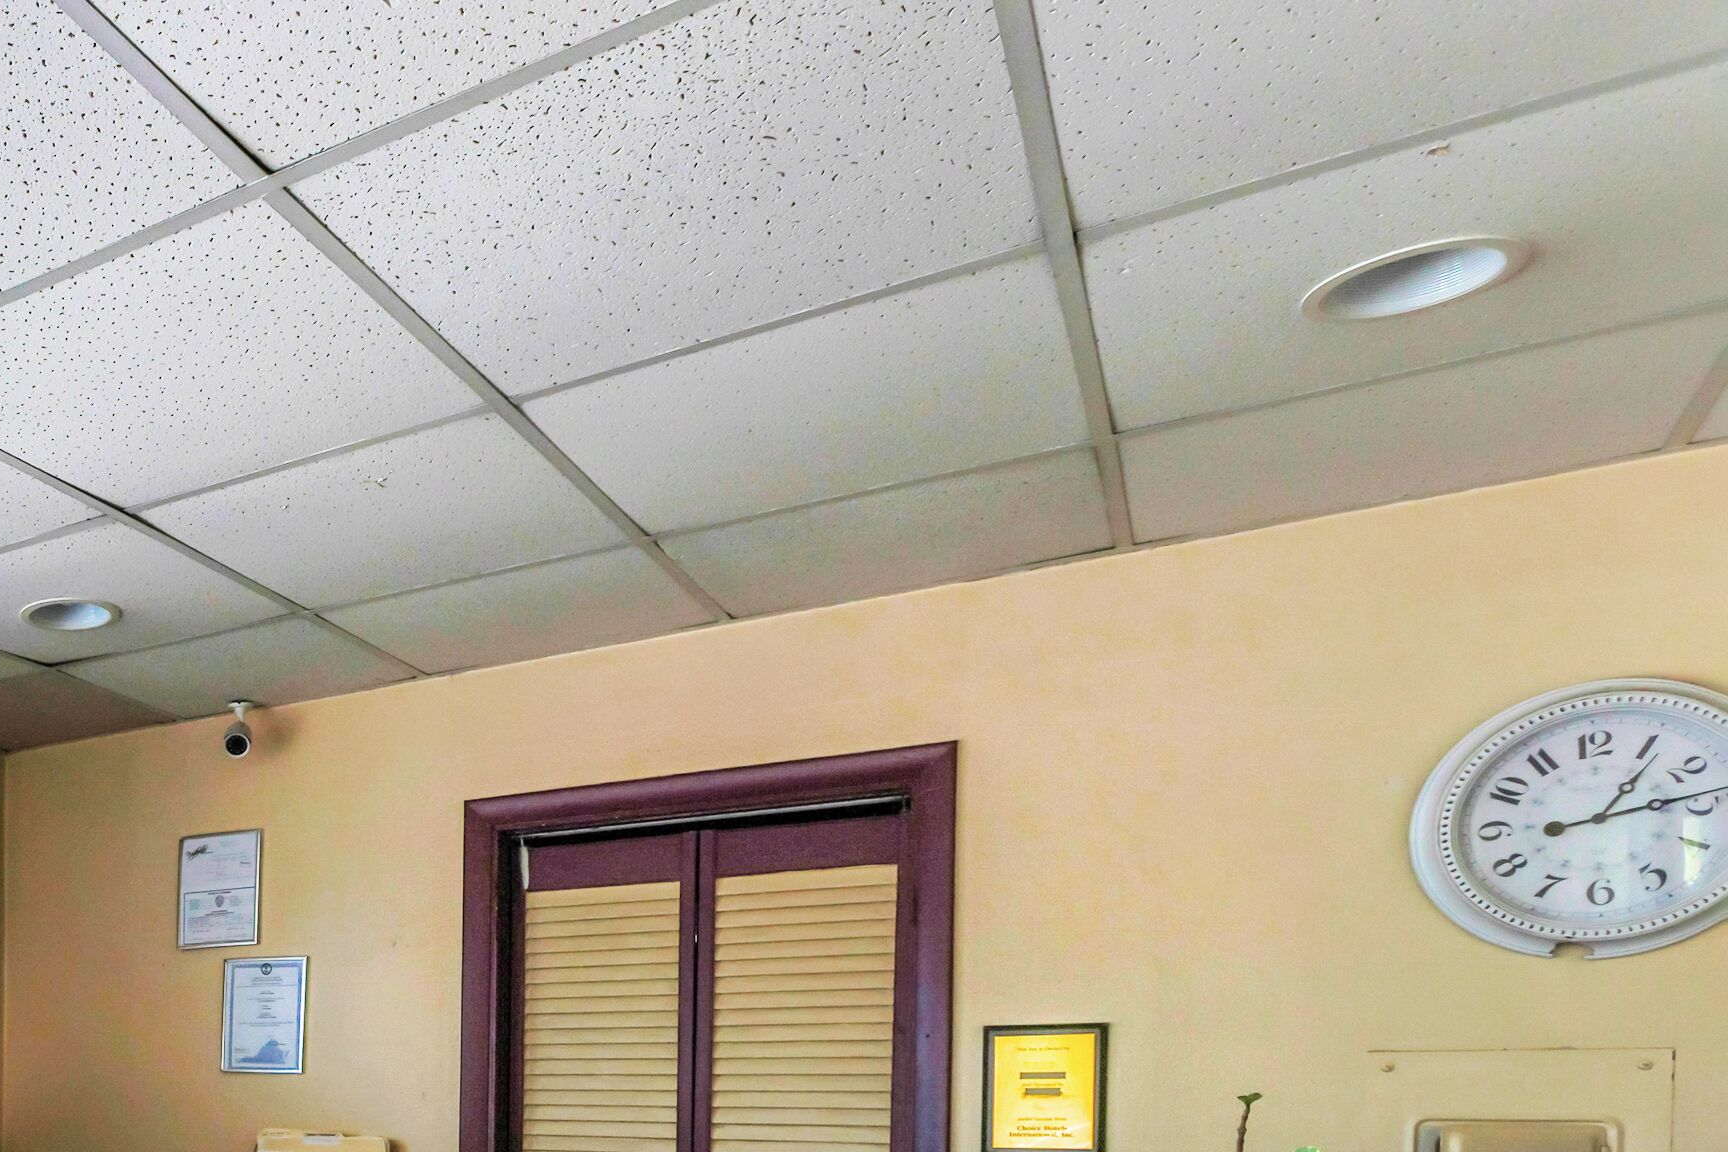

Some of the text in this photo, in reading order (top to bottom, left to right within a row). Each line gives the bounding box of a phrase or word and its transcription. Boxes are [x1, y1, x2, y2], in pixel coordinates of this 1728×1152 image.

[1577, 729, 1613, 760] 12
[1635, 734, 1660, 760] 1
[1526, 748, 1560, 776] 11
[1489, 776, 1529, 806] 10
[1478, 820, 1513, 842] 9
[1493, 853, 1528, 878] 8
[1638, 862, 1668, 892] 5
[1533, 874, 1568, 899] 7
[1586, 879, 1615, 906] 6
